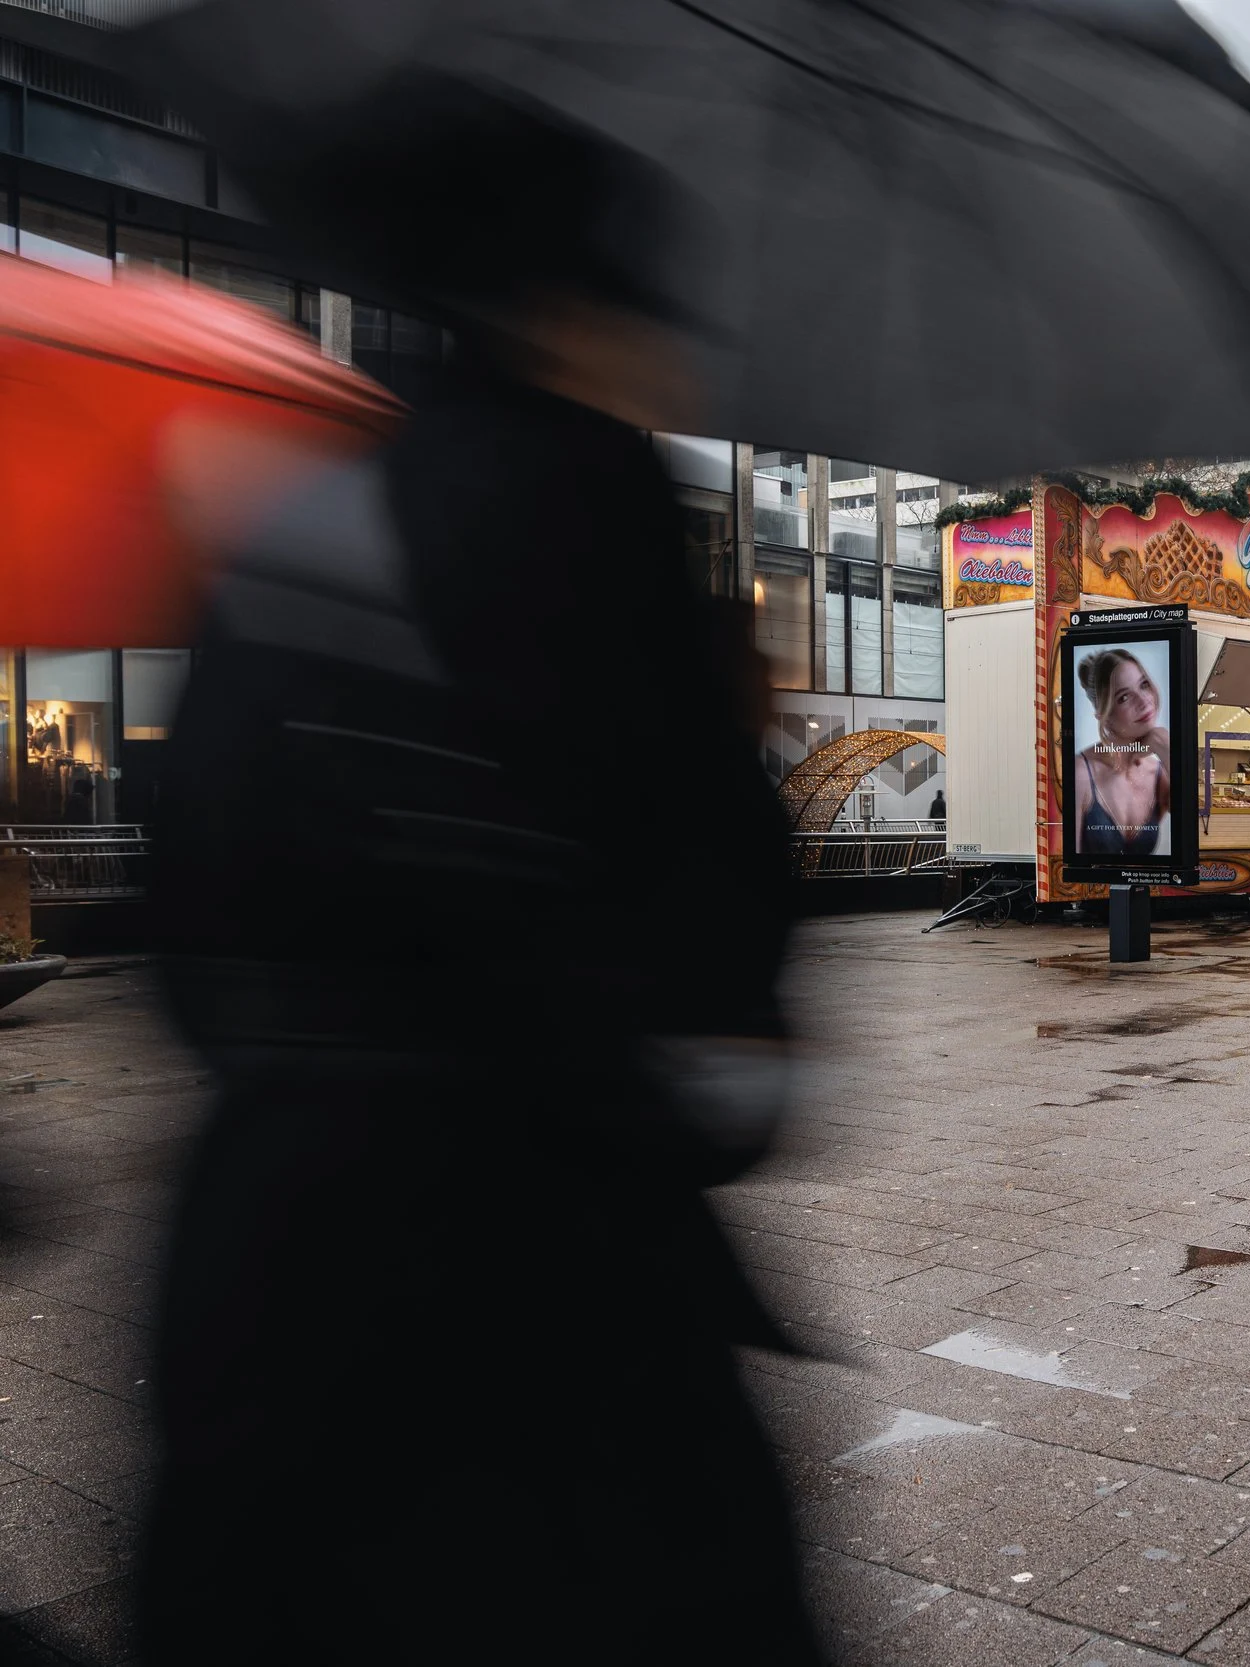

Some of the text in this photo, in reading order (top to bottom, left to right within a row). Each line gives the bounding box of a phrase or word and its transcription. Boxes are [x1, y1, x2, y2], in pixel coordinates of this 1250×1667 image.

[960, 558, 1033, 586] Oliebollen
[1089, 611, 1148, 623] Stadsplattegrond
[1154, 609, 1167, 619] City
[1168, 609, 1184, 619] map
[1094, 741, 1150, 753] hunkemöller
